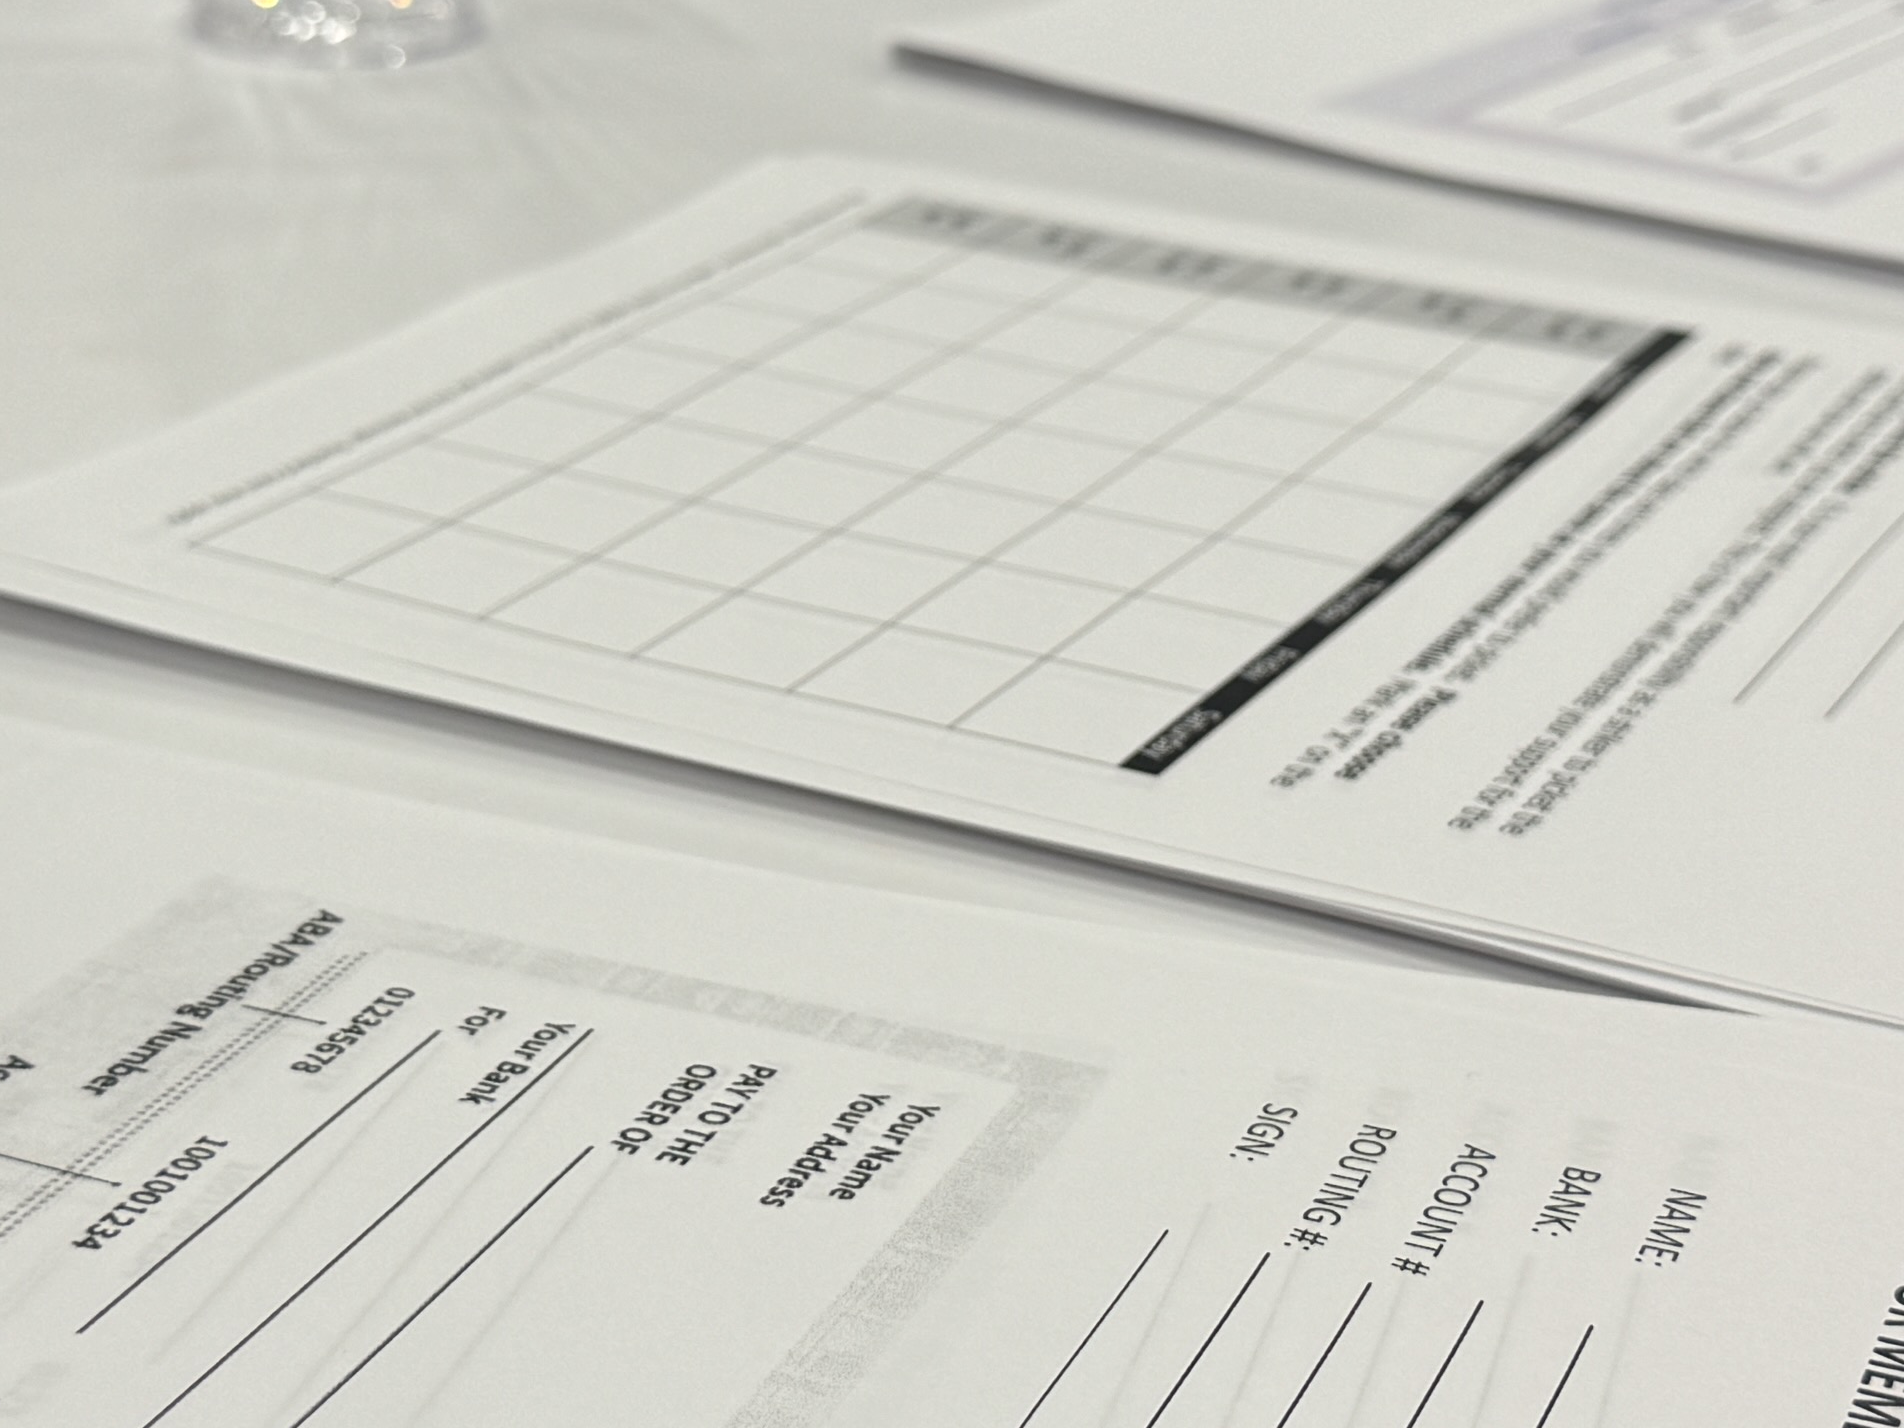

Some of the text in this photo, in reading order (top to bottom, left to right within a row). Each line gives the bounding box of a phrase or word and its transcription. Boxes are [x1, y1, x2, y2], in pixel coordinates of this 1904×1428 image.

[1476, 782, 1516, 808] for
[1493, 734, 1560, 787] support
[1562, 755, 1598, 773] to
[1446, 804, 1494, 830] the
[1498, 810, 1546, 836] the
[81, 909, 344, 1097] ABA/Routing Number
[290, 986, 415, 1074] 012345678
[457, 1005, 507, 1038] For
[458, 1022, 576, 1106] Your Bank
[610, 1064, 718, 1156] ORDER OF
[655, 1063, 778, 1166] PAY TO THE
[760, 1092, 891, 1208] Your Address
[827, 1104, 941, 1200] Your Name
[1230, 1103, 1298, 1163] SIGN:
[71, 1135, 229, 1251] 1001001234
[1284, 1124, 1398, 1251] ROUTING #:
[1391, 1143, 1497, 1276] ACCOUNT #
[1531, 1166, 1601, 1237] BANK:
[1635, 1187, 1707, 1267] NAME:
